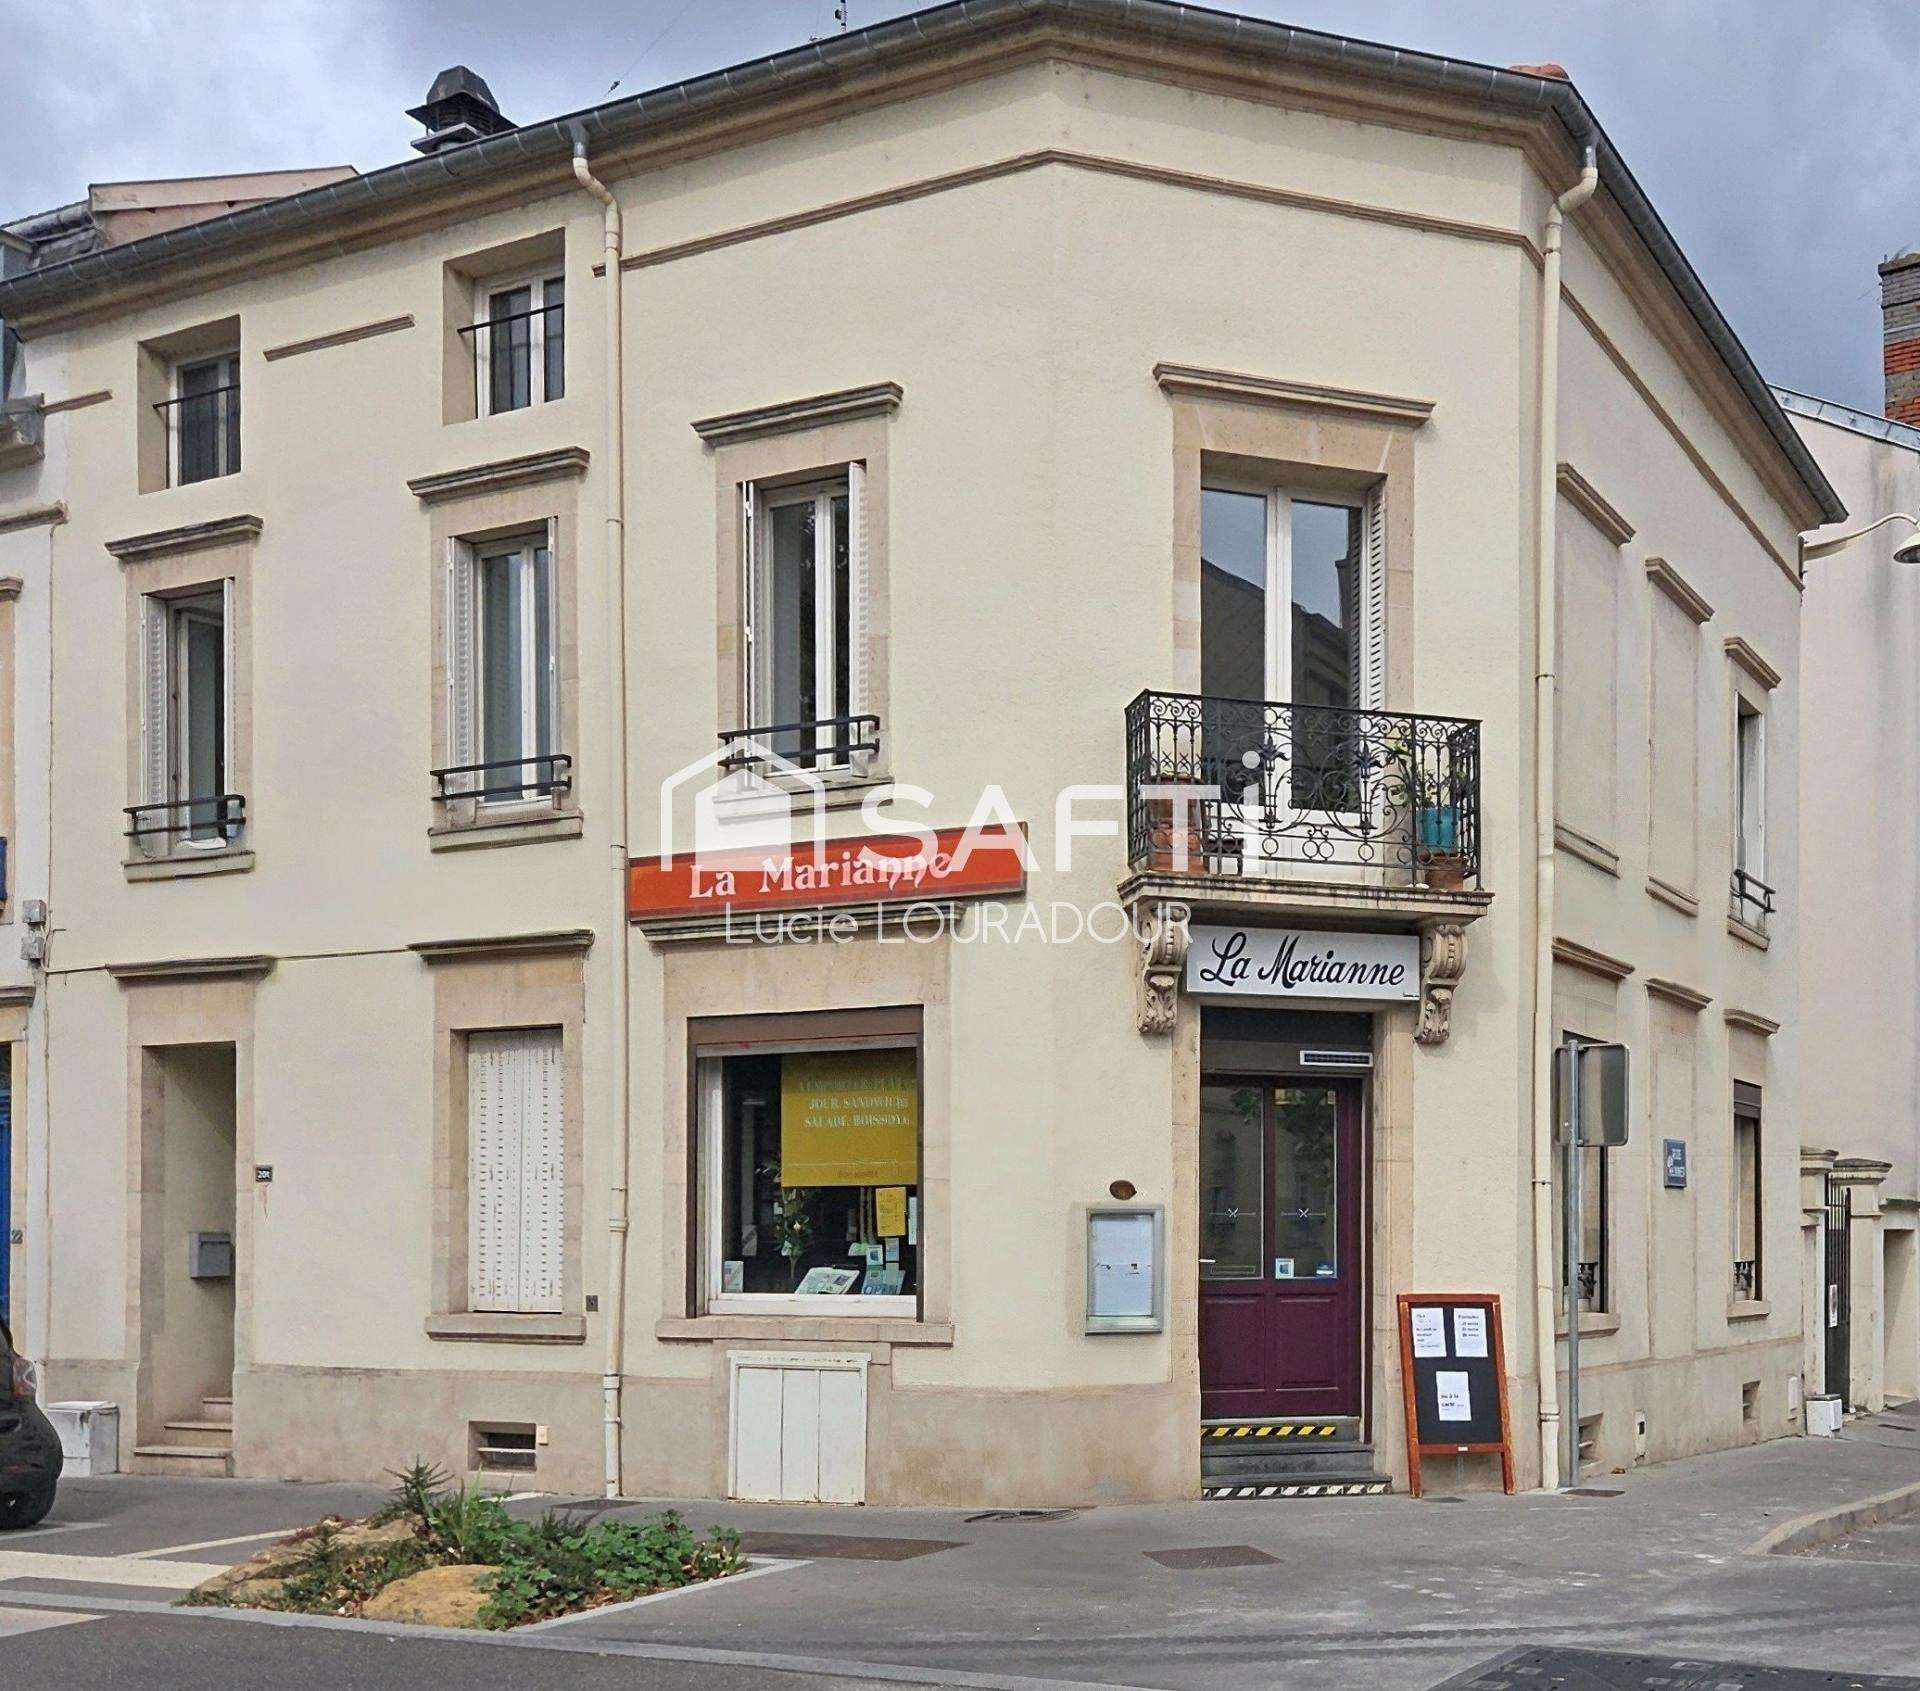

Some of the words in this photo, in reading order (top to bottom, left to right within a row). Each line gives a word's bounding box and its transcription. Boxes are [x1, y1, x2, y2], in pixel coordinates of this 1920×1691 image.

[688, 864, 736, 899] La
[759, 851, 953, 892] Marianne
[1199, 931, 1252, 987] La
[1257, 934, 1406, 989] Marianne
